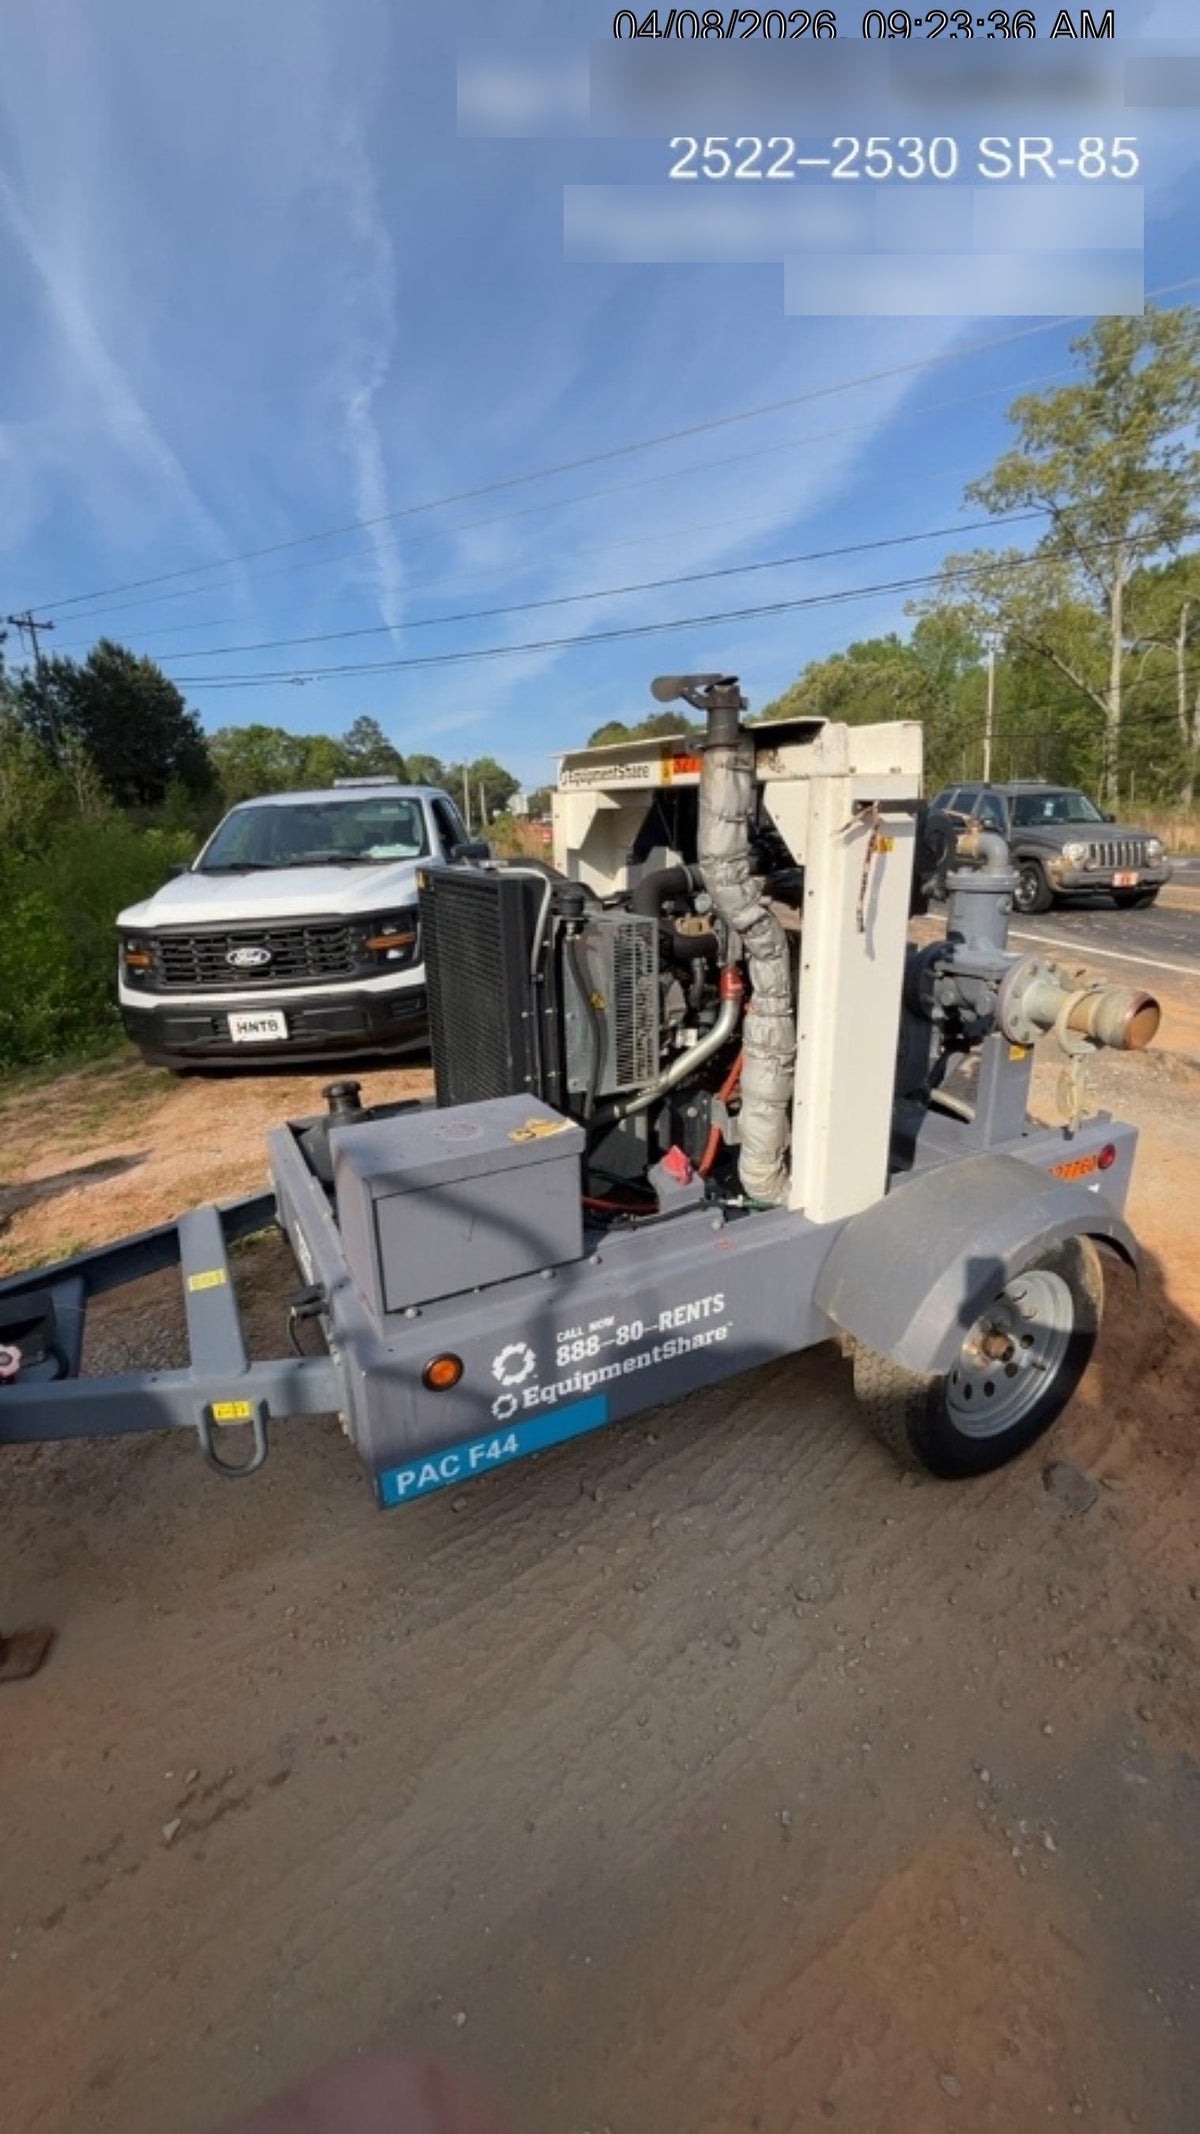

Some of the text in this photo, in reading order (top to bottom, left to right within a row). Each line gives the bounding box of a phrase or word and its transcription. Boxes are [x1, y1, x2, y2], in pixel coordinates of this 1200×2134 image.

[236, 1019, 279, 1034] HNTB
[556, 1315, 616, 1343] CALL NOW
[396, 1432, 519, 1495] PAC F44
